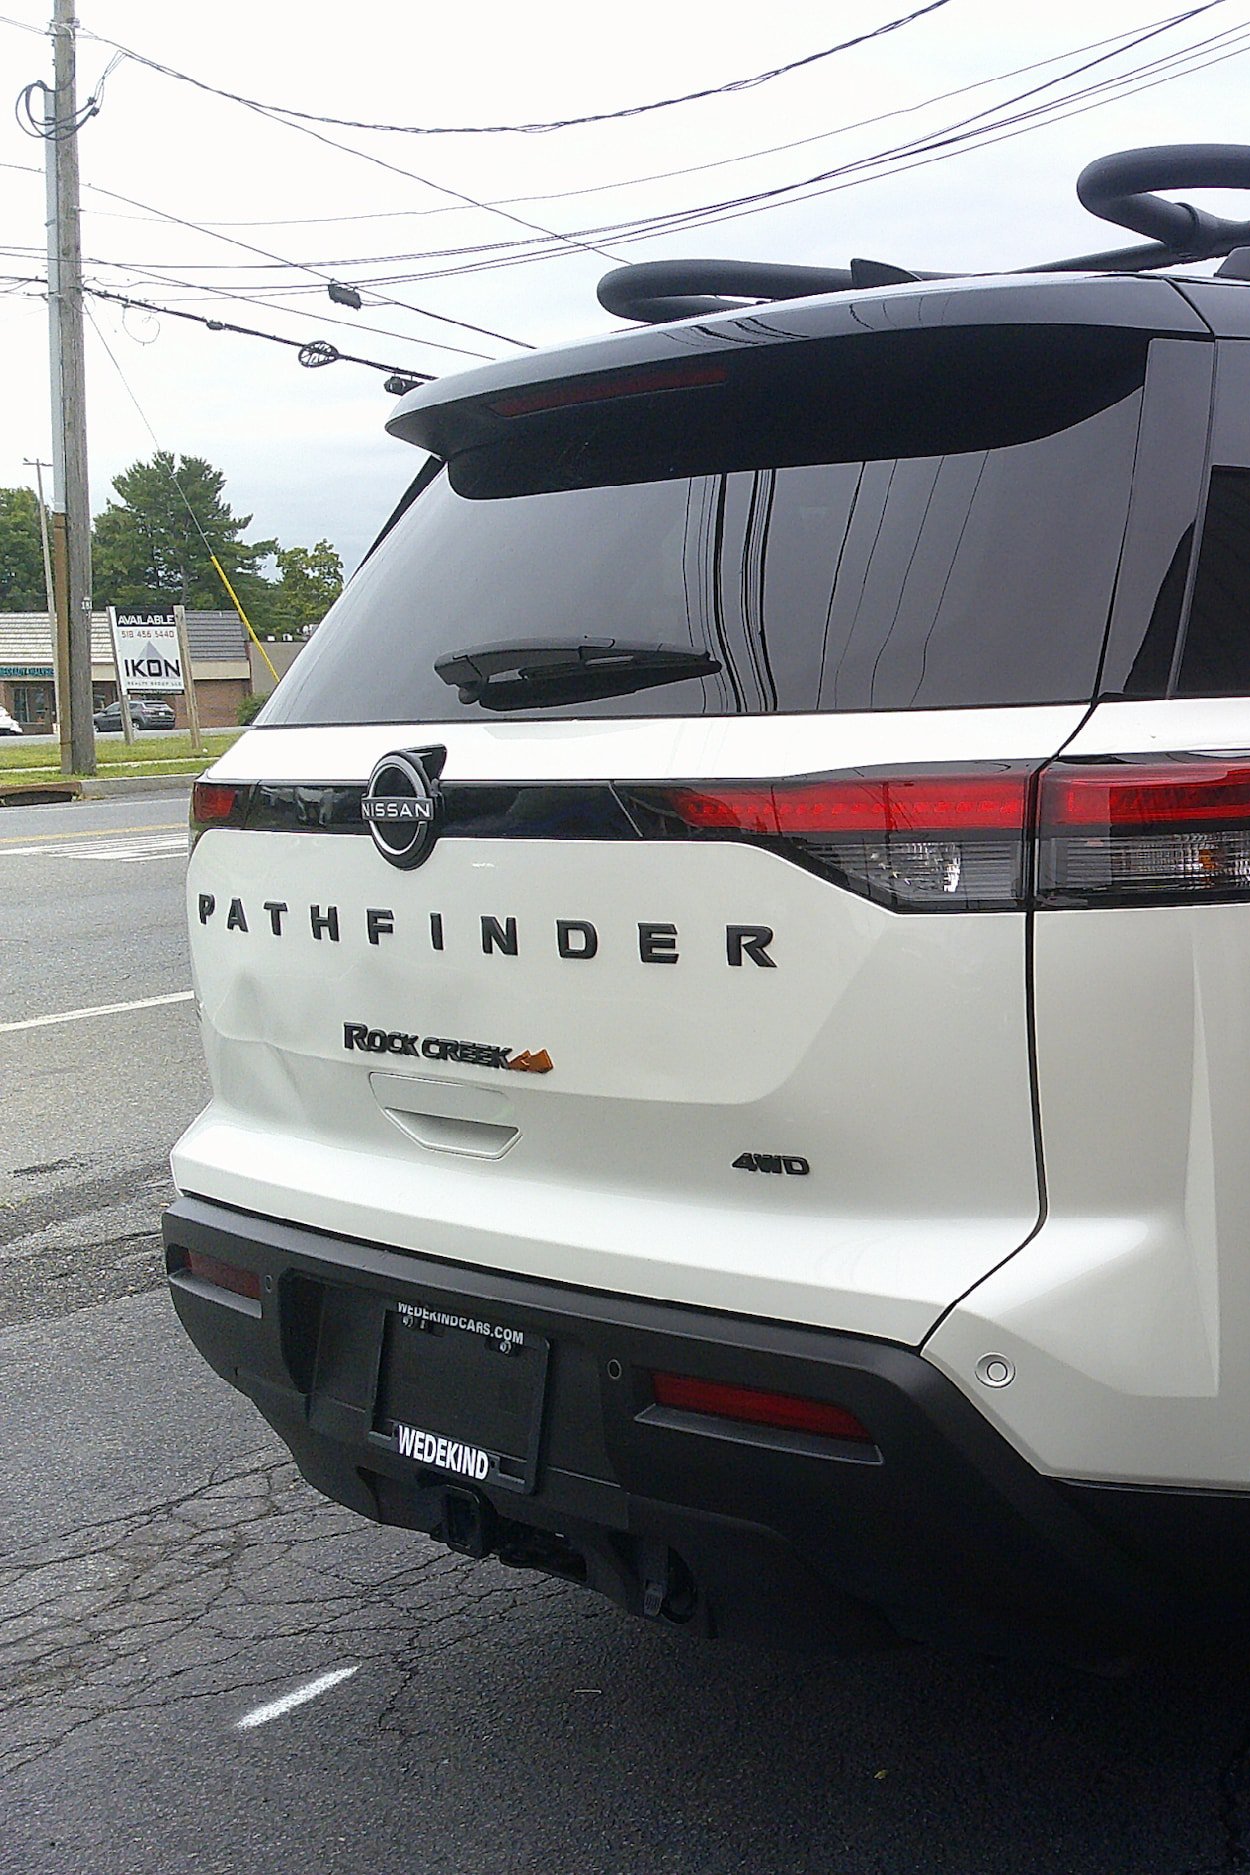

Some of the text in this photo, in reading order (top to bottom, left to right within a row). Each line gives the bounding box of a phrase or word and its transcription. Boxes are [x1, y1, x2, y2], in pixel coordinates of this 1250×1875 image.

[117, 614, 175, 625] AVAILABLE
[121, 630, 175, 639] 518 456 5440
[124, 659, 181, 678] IKON
[361, 802, 431, 818] NISSAN
[198, 892, 778, 968] PATHFINDER
[343, 1021, 513, 1070] ROCK CREEK
[731, 1152, 810, 1175] 4WD
[398, 1301, 524, 1345] WEDEKINDCARS.COM
[398, 1424, 490, 1480] WEDEKIND
